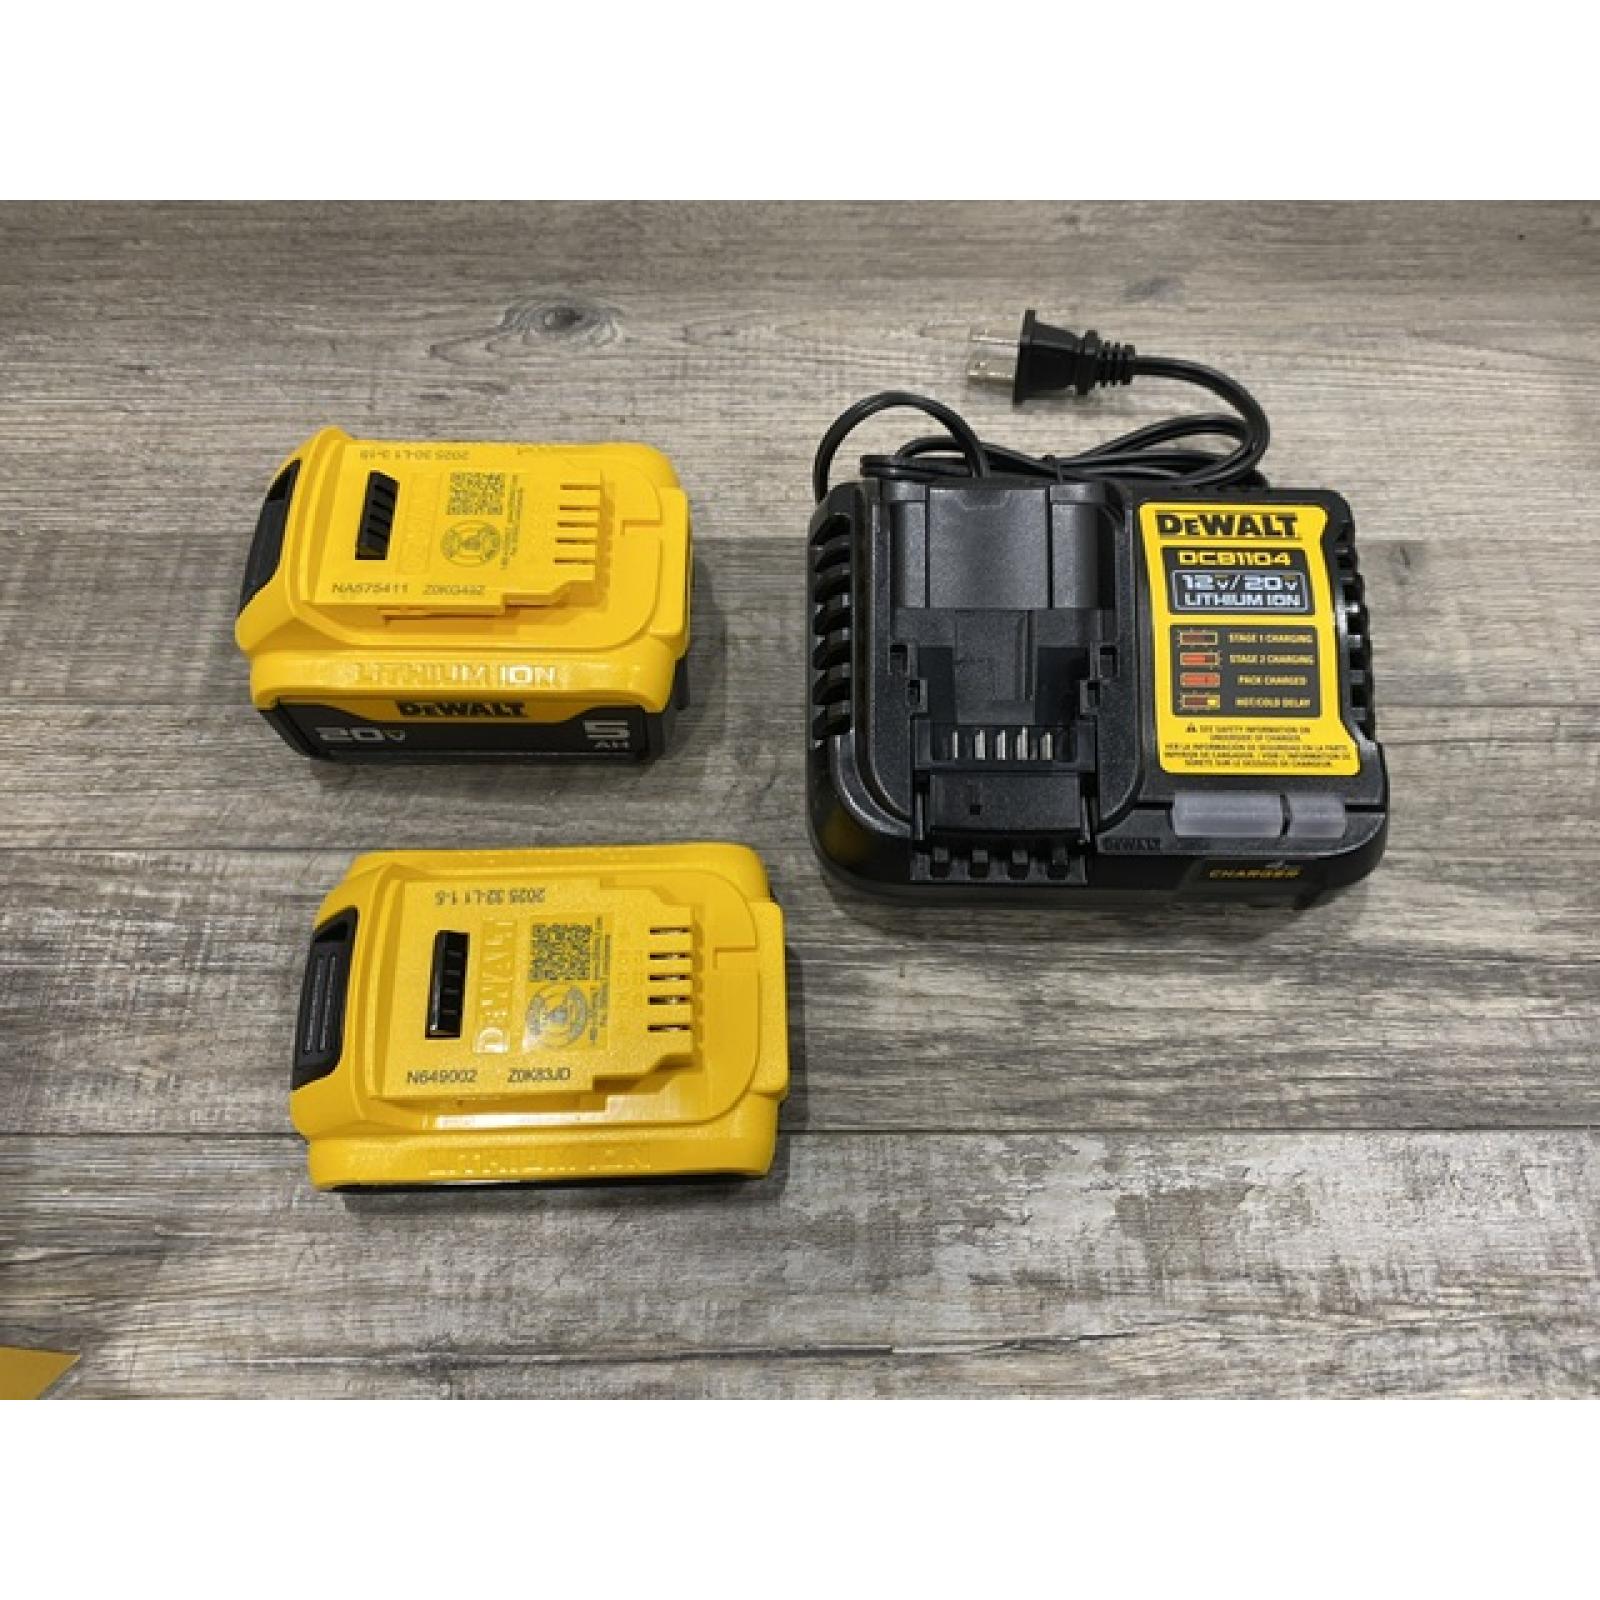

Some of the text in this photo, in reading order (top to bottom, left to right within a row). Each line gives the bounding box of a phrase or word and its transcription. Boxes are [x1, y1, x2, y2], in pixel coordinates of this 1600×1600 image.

[1156, 513, 1298, 536] DEWALT
[1178, 551, 1291, 566] DCB1104
[1184, 592, 1300, 606] LITHIUM ION
[1229, 653, 1258, 664] STAGE
[353, 662, 558, 687] LITHIUM ION
[1238, 674, 1261, 685] PACK
[396, 700, 528, 718] DEWALT
[583, 719, 630, 738] 5
[508, 888, 546, 904] 2025
[406, 1069, 479, 1084] N649002
